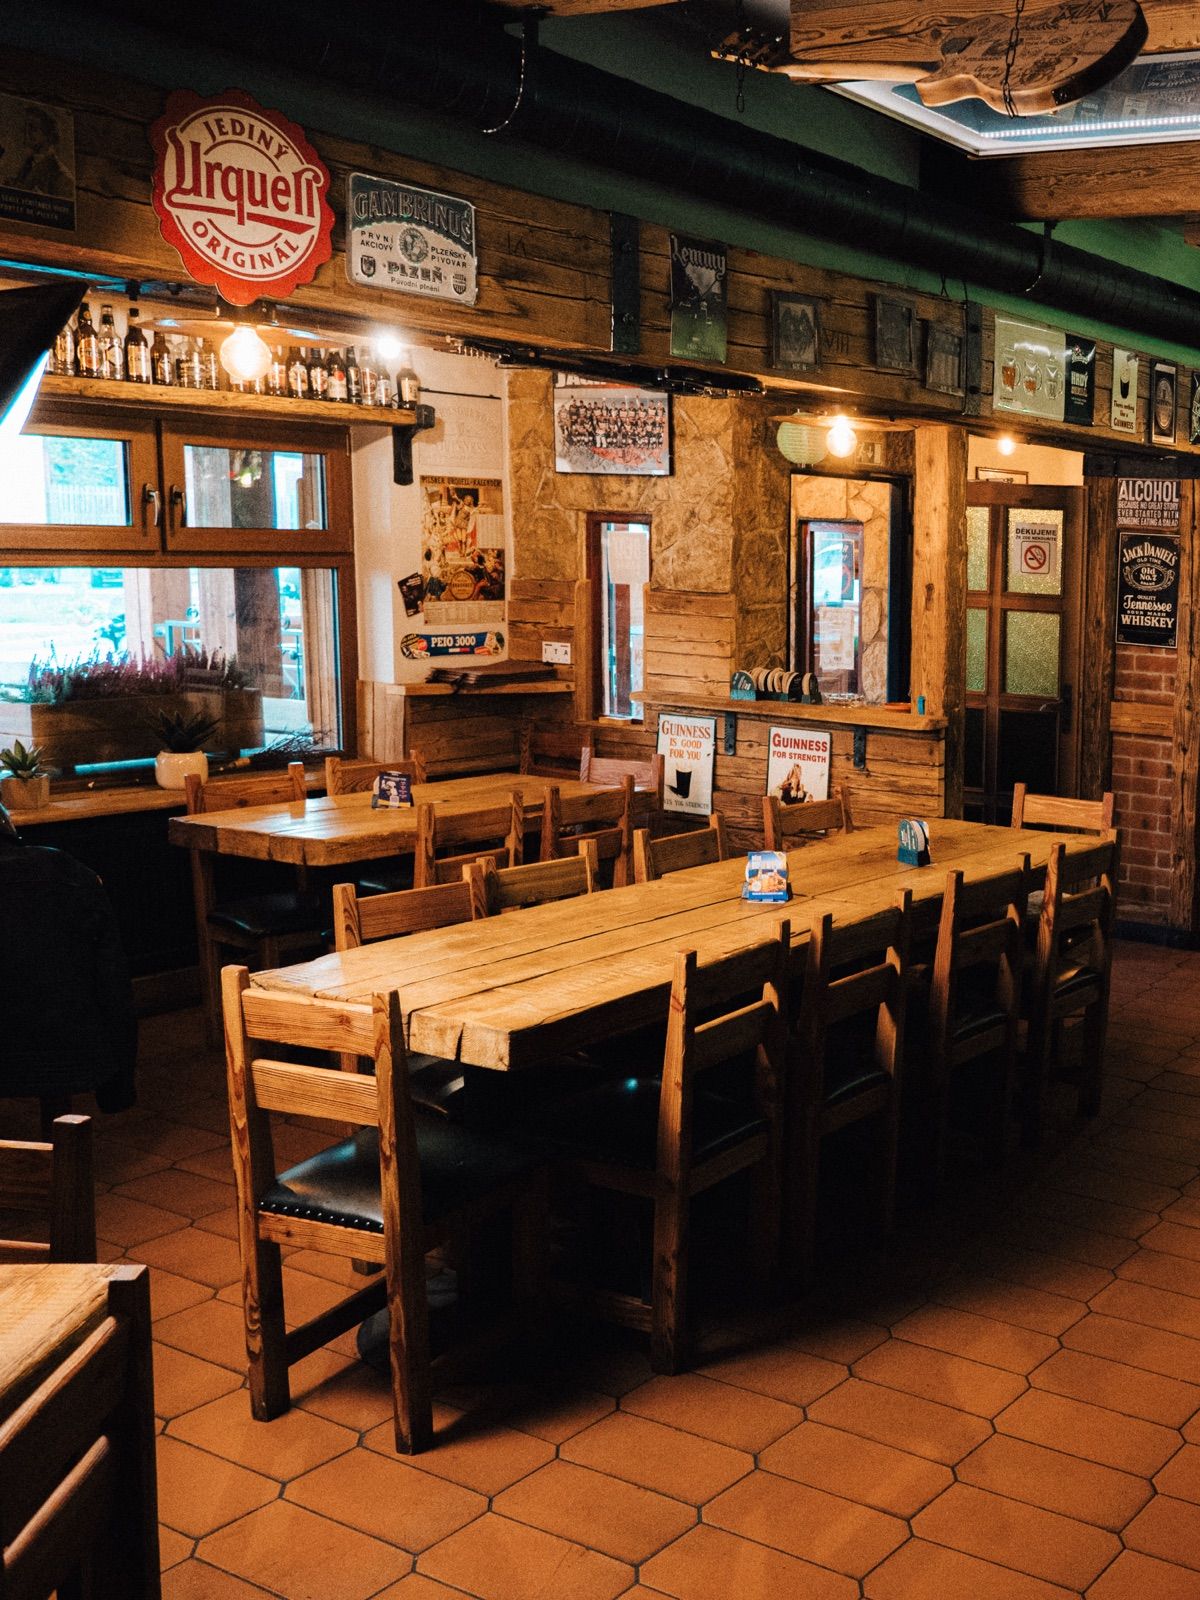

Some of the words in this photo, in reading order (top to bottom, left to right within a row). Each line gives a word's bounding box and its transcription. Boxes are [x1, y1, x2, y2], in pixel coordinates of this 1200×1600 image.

[203, 117, 290, 161] JEDINÝ
[165, 127, 323, 227] Urquell
[353, 190, 473, 245] GAMBRINUS
[360, 230, 394, 243] PRVNÍ
[192, 220, 299, 270] ORIGINÁL
[360, 239, 394, 252] AKCIOVÝ
[430, 254, 467, 268] PIVOVAR
[670, 233, 726, 281] Lemmy
[387, 261, 443, 283] PLZEŇ
[1118, 480, 1179, 503] ALCOHOL
[1118, 501, 1140, 509] BECAUSE
[1140, 501, 1148, 510] NO
[1148, 502, 1163, 510] GREAT
[1163, 502, 1179, 511] STORY
[1118, 508, 1133, 517] EVER
[1135, 509, 1162, 519] STARTED
[1163, 510, 1179, 519] WITH
[1118, 516, 1140, 525] SOMEONE
[1140, 517, 1158, 526] EATING
[1162, 518, 1179, 527] SALAD
[1122, 544, 1143, 563] JACK
[1141, 567, 1156, 575] Old
[1123, 594, 1172, 612] Tennessee
[1121, 614, 1175, 628] WHISKEY
[431, 636, 454, 648] PEIO
[454, 635, 476, 647] 3000
[661, 719, 711, 739] GUINNESS
[669, 737, 678, 747] IS
[681, 739, 703, 748] GOOD
[772, 733, 828, 753] GUINNESS
[669, 748, 685, 759] FOR
[686, 750, 702, 760] YOU
[772, 750, 787, 759] FOR
[788, 751, 827, 764] STRENGTH
